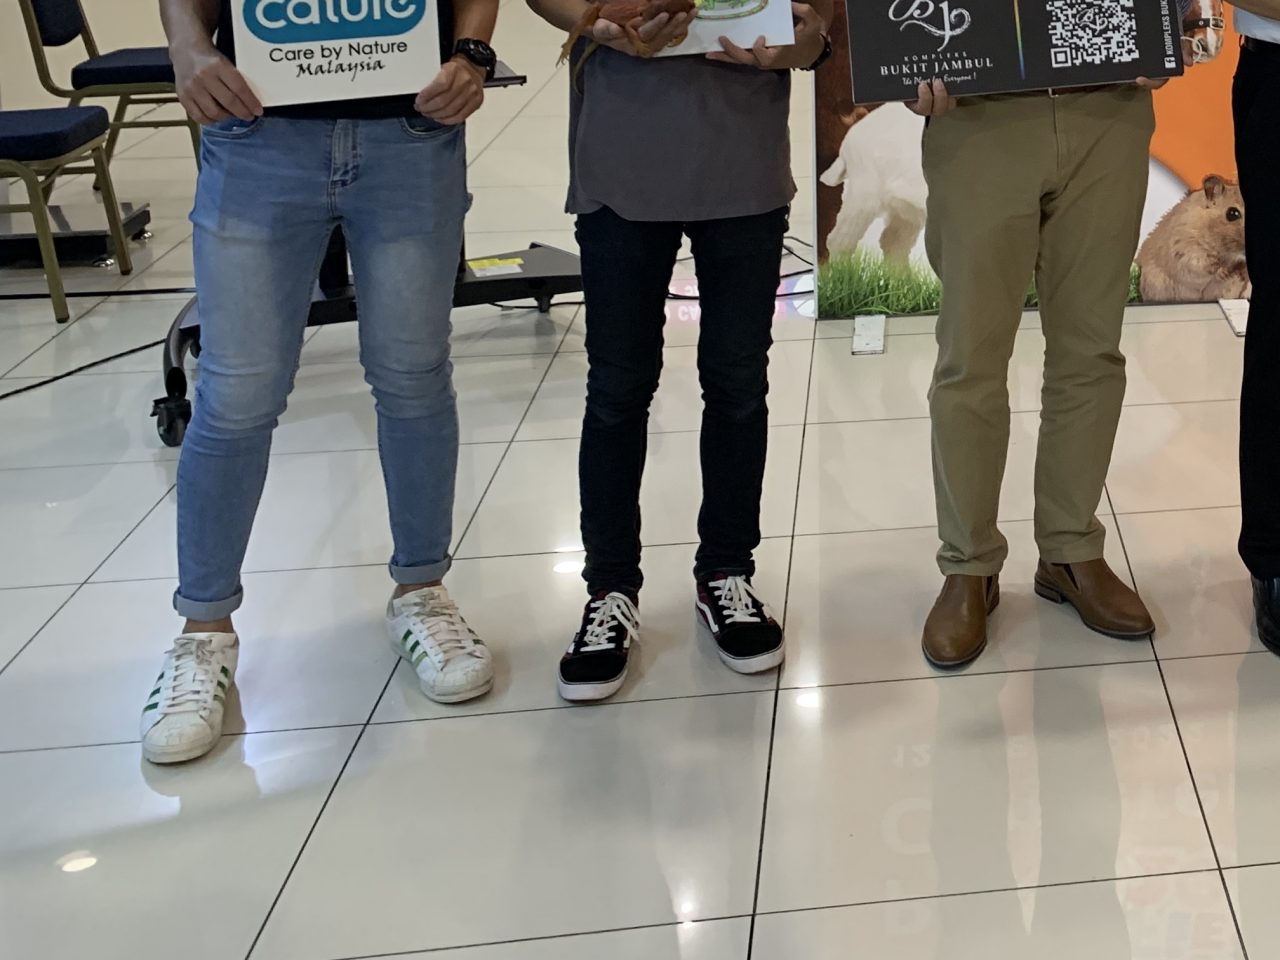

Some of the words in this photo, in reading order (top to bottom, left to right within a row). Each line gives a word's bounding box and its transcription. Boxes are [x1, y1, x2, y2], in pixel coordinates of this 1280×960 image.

[1162, 15, 1174, 55] KOMPLEKS
[269, 47, 315, 62] Care
[320, 44, 343, 61] by
[348, 41, 408, 56] Nature
[295, 56, 386, 82] Malaysia
[880, 62, 929, 76] BUKIT
[934, 57, 994, 74] JAMBUL
